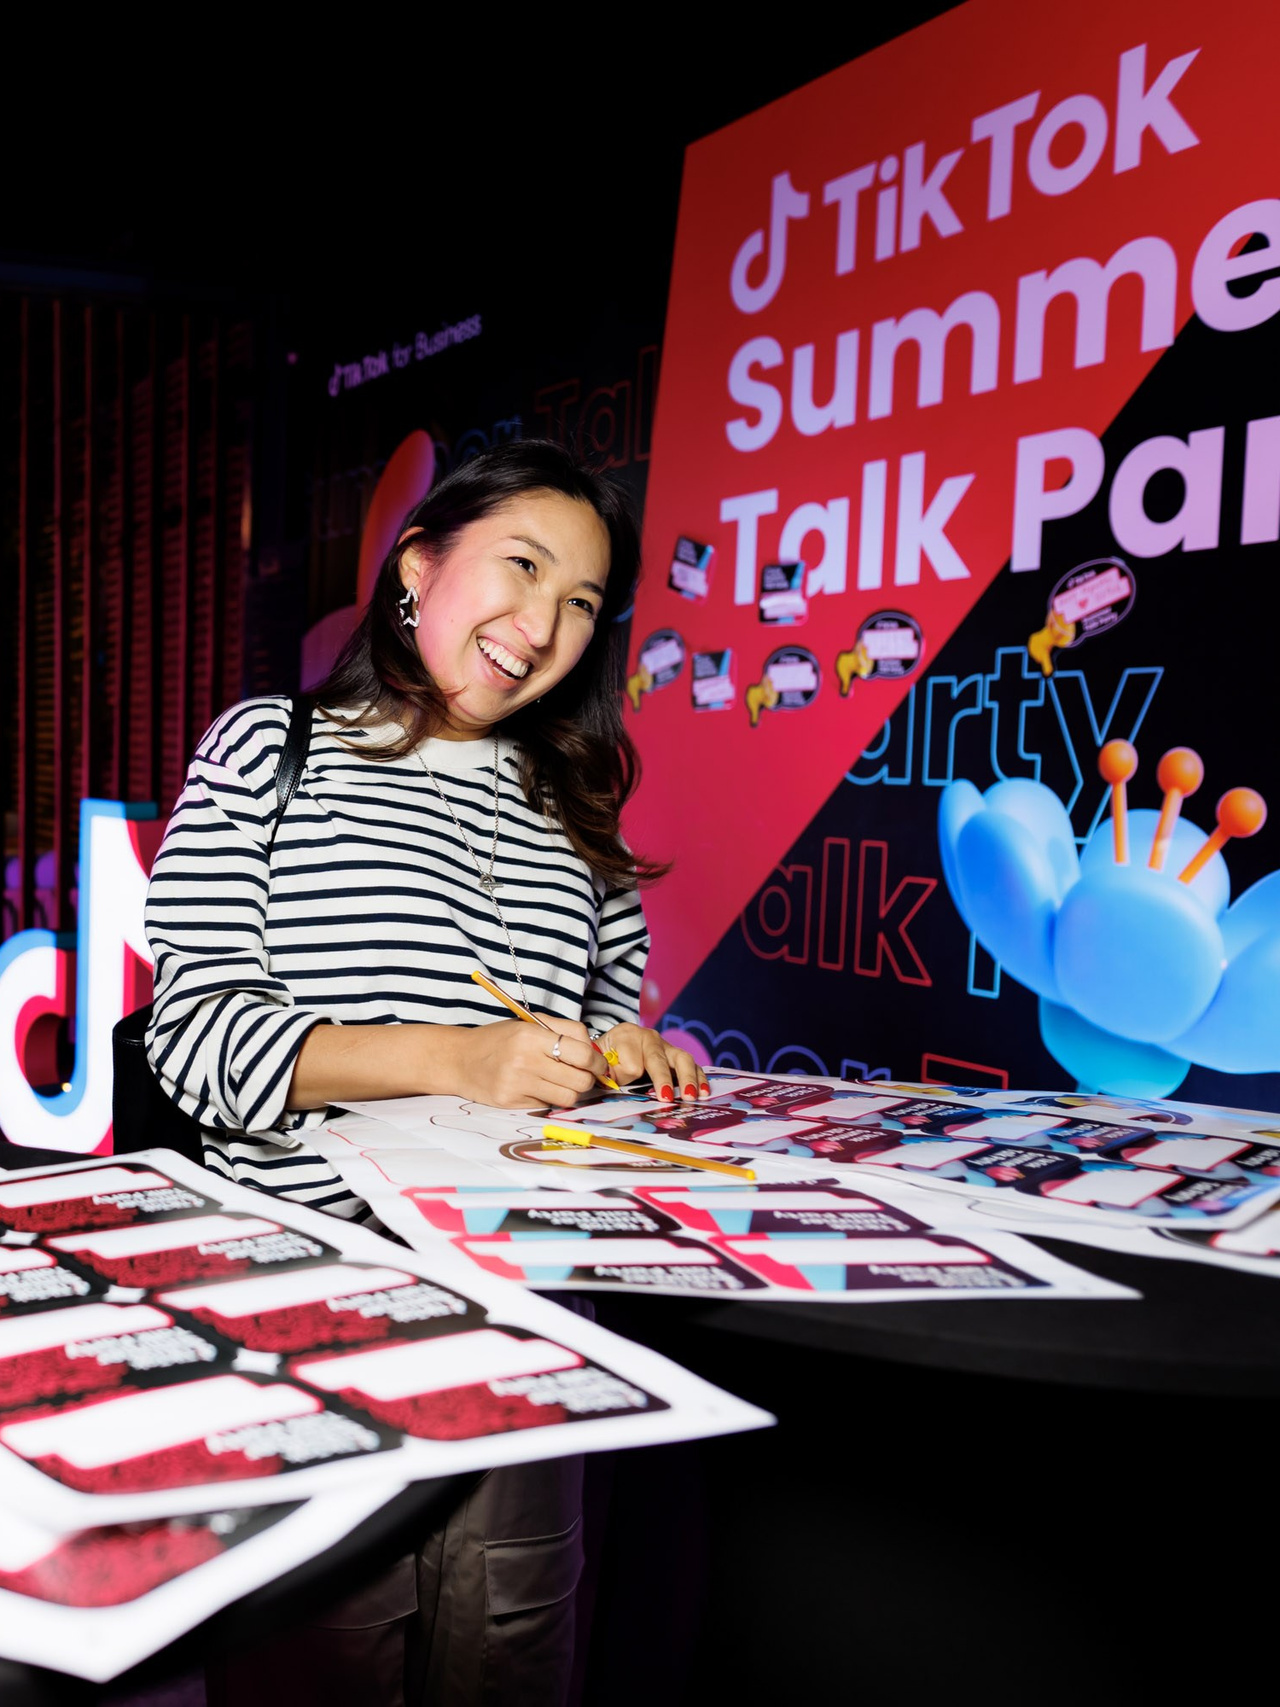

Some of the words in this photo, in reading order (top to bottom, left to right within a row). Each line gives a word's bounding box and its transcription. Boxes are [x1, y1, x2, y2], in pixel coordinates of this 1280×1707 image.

[823, 42, 1202, 277] TikTok
[415, 313, 482, 360] Business
[719, 451, 976, 606] Talk
